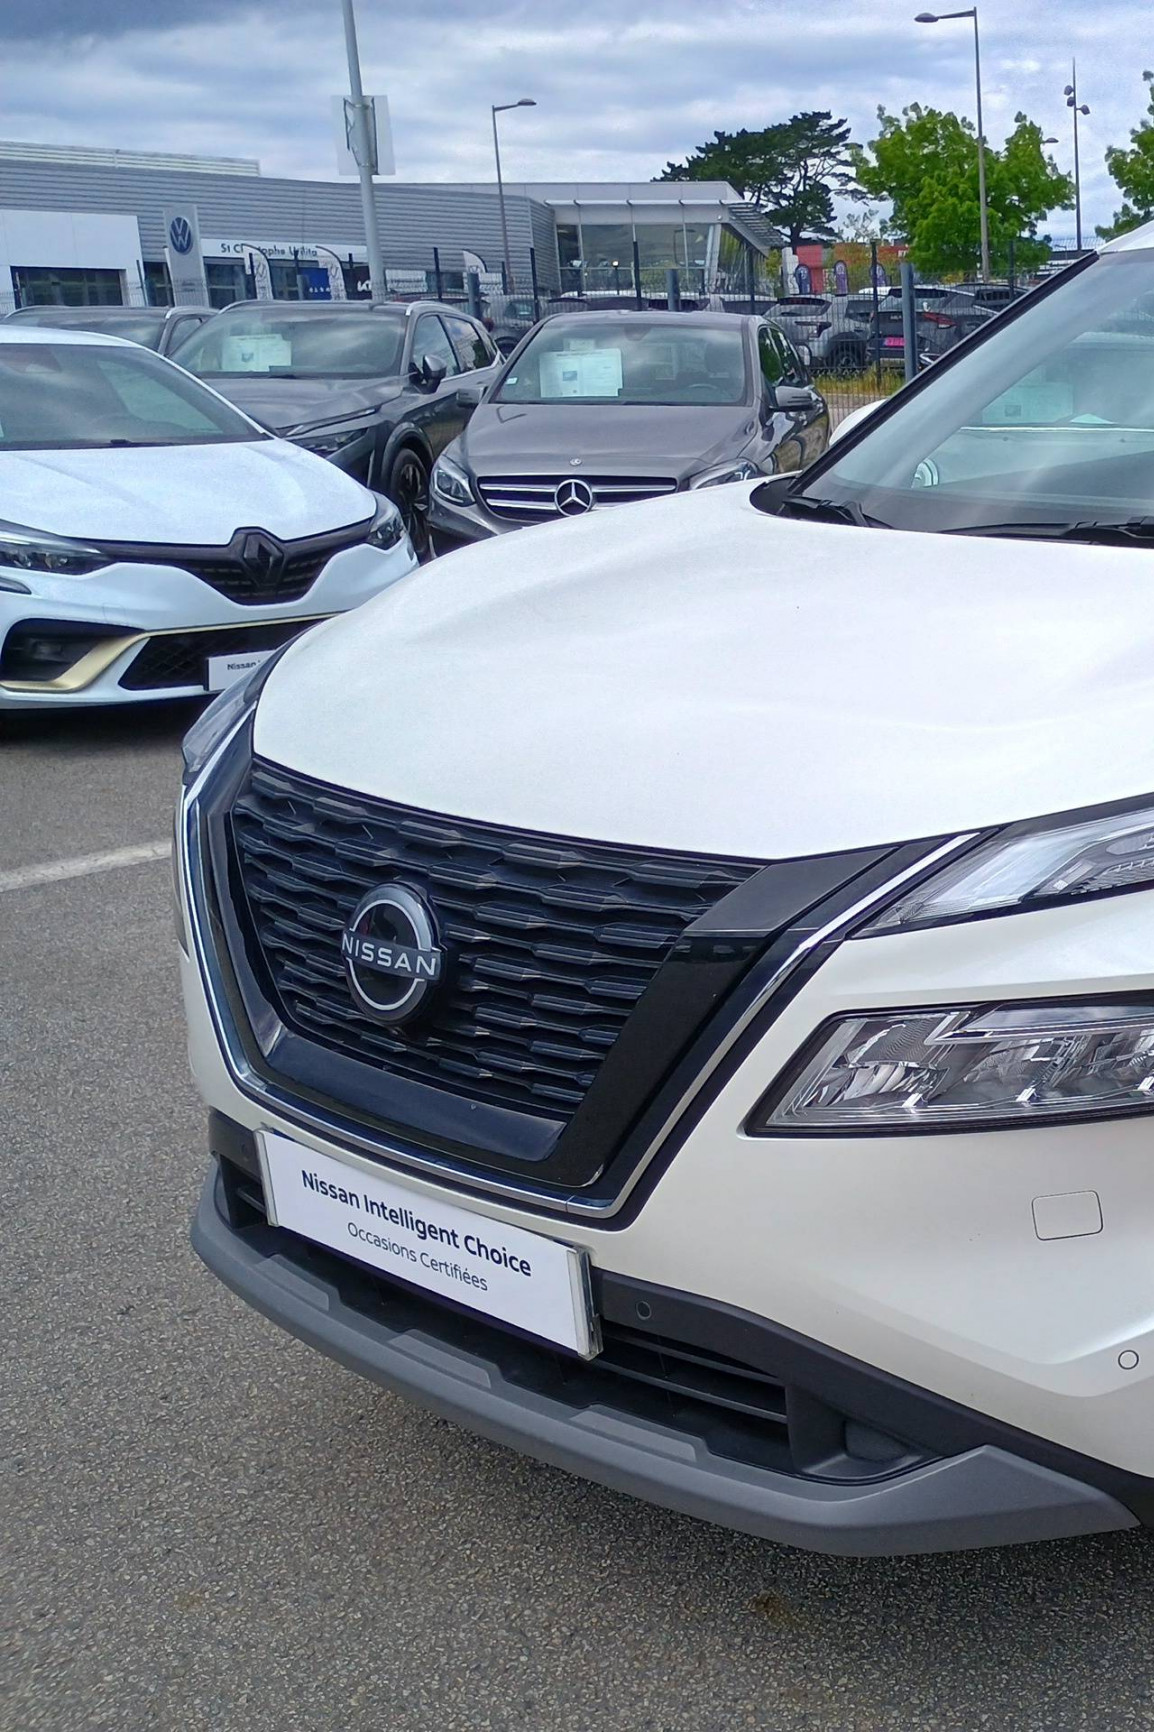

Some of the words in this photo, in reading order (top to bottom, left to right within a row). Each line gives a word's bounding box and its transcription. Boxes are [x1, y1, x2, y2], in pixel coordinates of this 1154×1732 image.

[227, 662, 257, 670] Nissan
[342, 933, 436, 976] NISSAN
[301, 1170, 361, 1211] Nissan
[364, 1194, 460, 1250] Intelligent
[464, 1235, 532, 1278] Choice
[347, 1222, 417, 1263] Occasions
[420, 1251, 489, 1292] Certifiées
